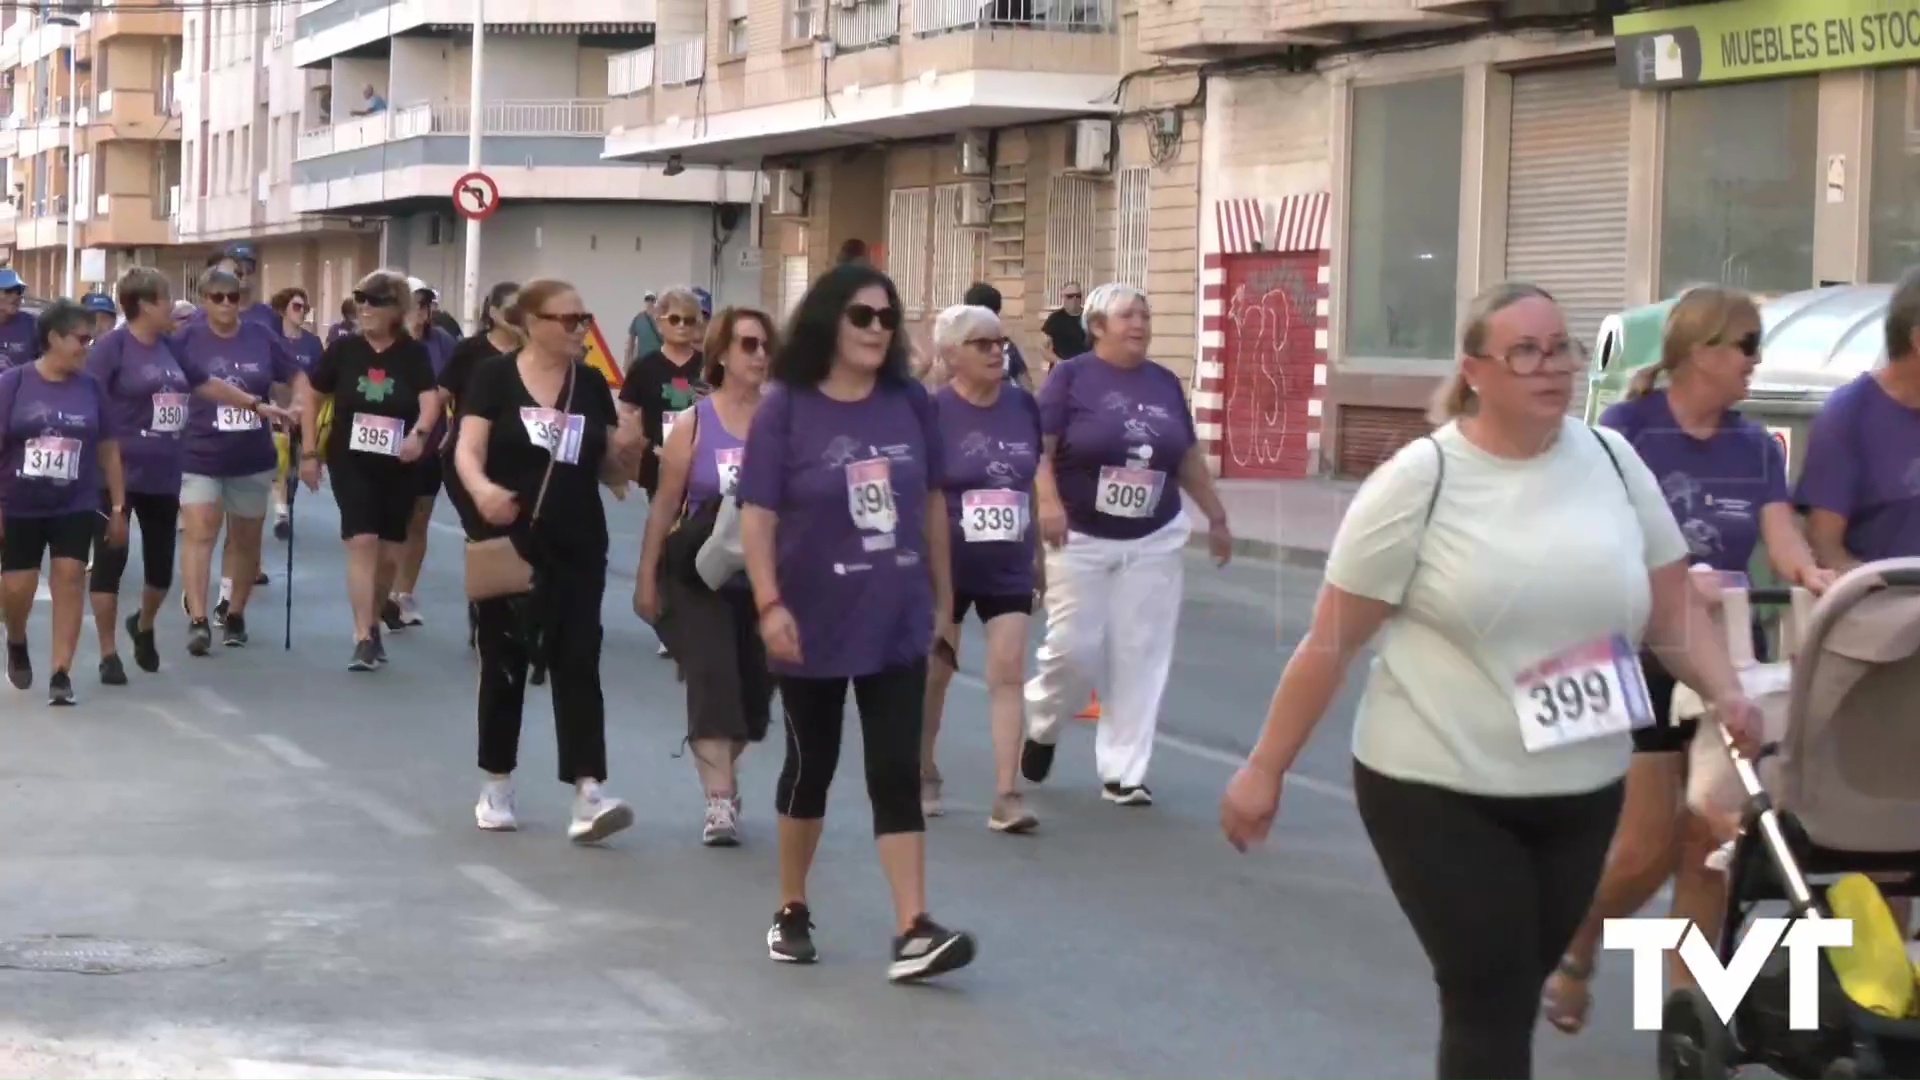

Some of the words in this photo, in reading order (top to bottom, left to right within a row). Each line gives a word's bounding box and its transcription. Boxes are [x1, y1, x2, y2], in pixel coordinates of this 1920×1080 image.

[1721, 22, 1818, 68] MUEBLES
[1824, 17, 1855, 56] EN
[159, 406, 181, 424] 350
[223, 406, 252, 424] 370
[358, 427, 389, 447] 395
[31, 449, 64, 470] 314
[1106, 483, 1146, 508] 309
[973, 507, 1014, 531] 339
[1531, 669, 1611, 727] 399
